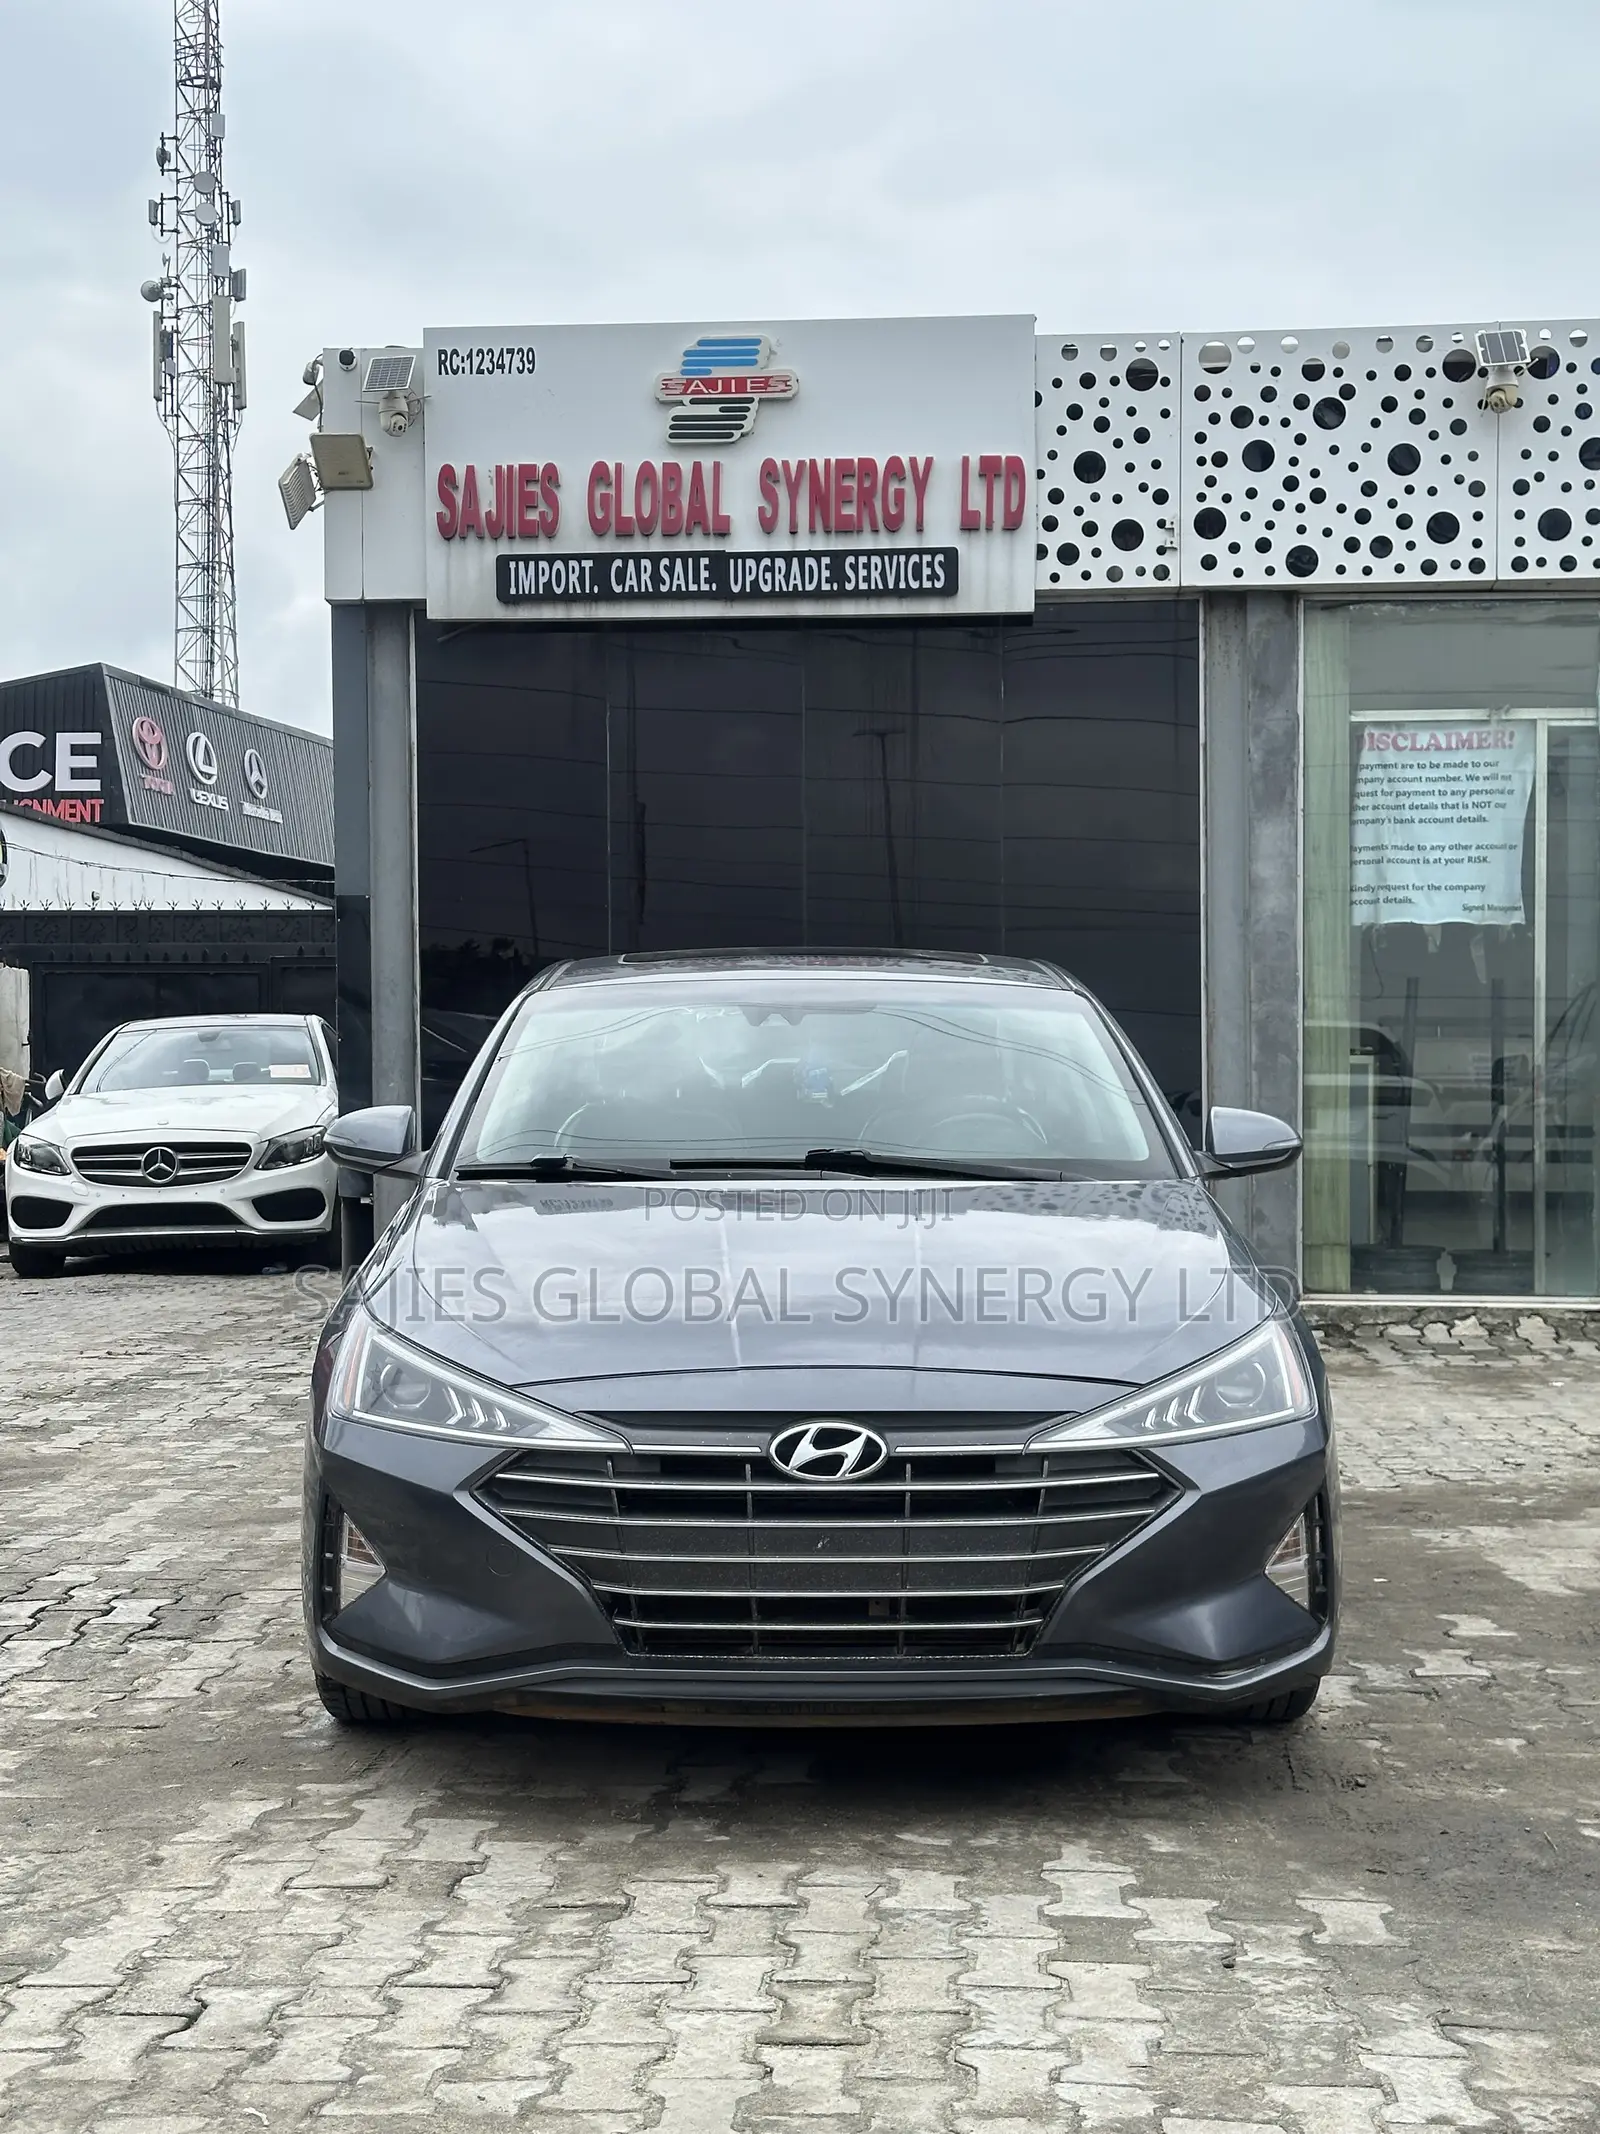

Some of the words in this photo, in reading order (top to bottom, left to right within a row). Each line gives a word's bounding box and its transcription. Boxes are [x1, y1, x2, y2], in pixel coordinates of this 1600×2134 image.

[437, 347, 536, 376] RC:1234739
[660, 374, 794, 396] SAJIES
[436, 461, 561, 540] SAJIES
[586, 460, 731, 537] GLOBAL
[757, 455, 934, 534] SYNERGY
[960, 454, 1026, 531] LTD
[509, 559, 599, 595] IMPORT.
[610, 557, 652, 594] CAR
[659, 556, 717, 593] SALE.
[729, 555, 838, 593] UPGRADE.
[844, 553, 945, 591] SERVICES
[1359, 762, 1398, 772] payment
[1417, 762, 1427, 770] to
[1429, 761, 1441, 769] be
[1442, 761, 1469, 769] made
[1387, 775, 1423, 783] account
[1465, 774, 1480, 782] We
[1483, 773, 1499, 781] will
[1381, 788, 1393, 797] for
[1396, 789, 1435, 798] payment
[1450, 789, 1467, 797] any
[190, 788, 229, 811] LEXUS
[1372, 803, 1406, 811] account
[1408, 802, 1438, 810] details
[1441, 801, 1459, 809] that
[1462, 801, 1469, 809] is
[1472, 801, 1492, 809] NOT
[1393, 816, 1416, 824] bank
[1418, 816, 1454, 824] account
[1456, 814, 1489, 823] details.
[1430, 844, 1446, 853] any
[1448, 843, 1473, 851] other
[1423, 856, 1430, 864] is
[1444, 857, 1465, 866] your
[1467, 856, 1491, 864] RISK.
[1412, 883, 1425, 891] for
[1427, 883, 1442, 891] the
[1444, 884, 1486, 893] company
